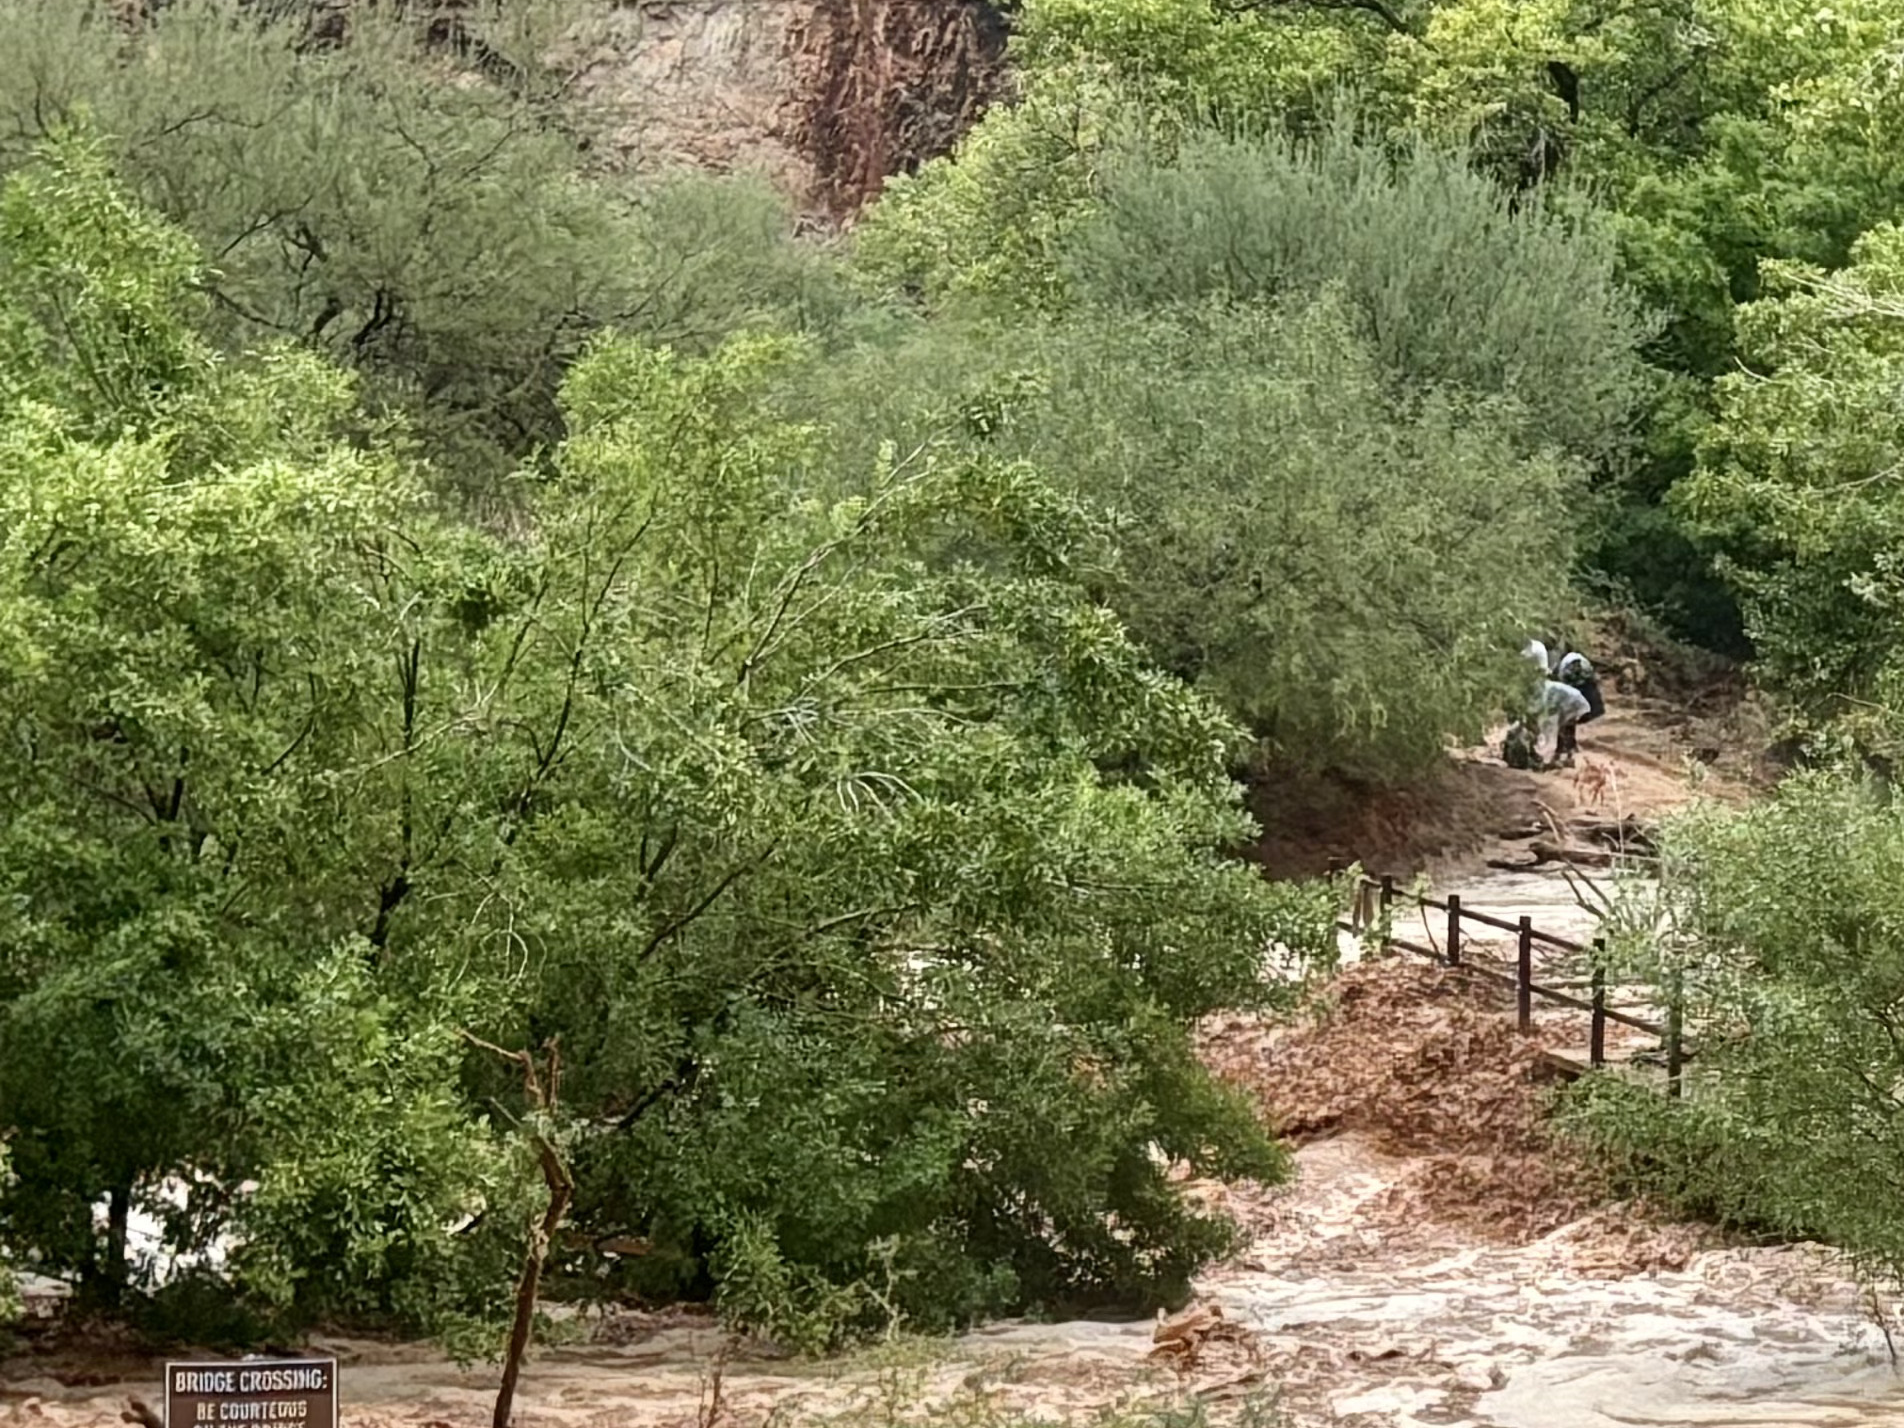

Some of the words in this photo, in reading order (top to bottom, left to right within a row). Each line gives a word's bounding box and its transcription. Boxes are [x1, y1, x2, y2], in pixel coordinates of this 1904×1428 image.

[175, 1371, 235, 1392] BRIDGE
[240, 1369, 328, 1392] CROSSING:
[197, 1403, 215, 1420] BE
[220, 1400, 307, 1420] COURTEOUS
